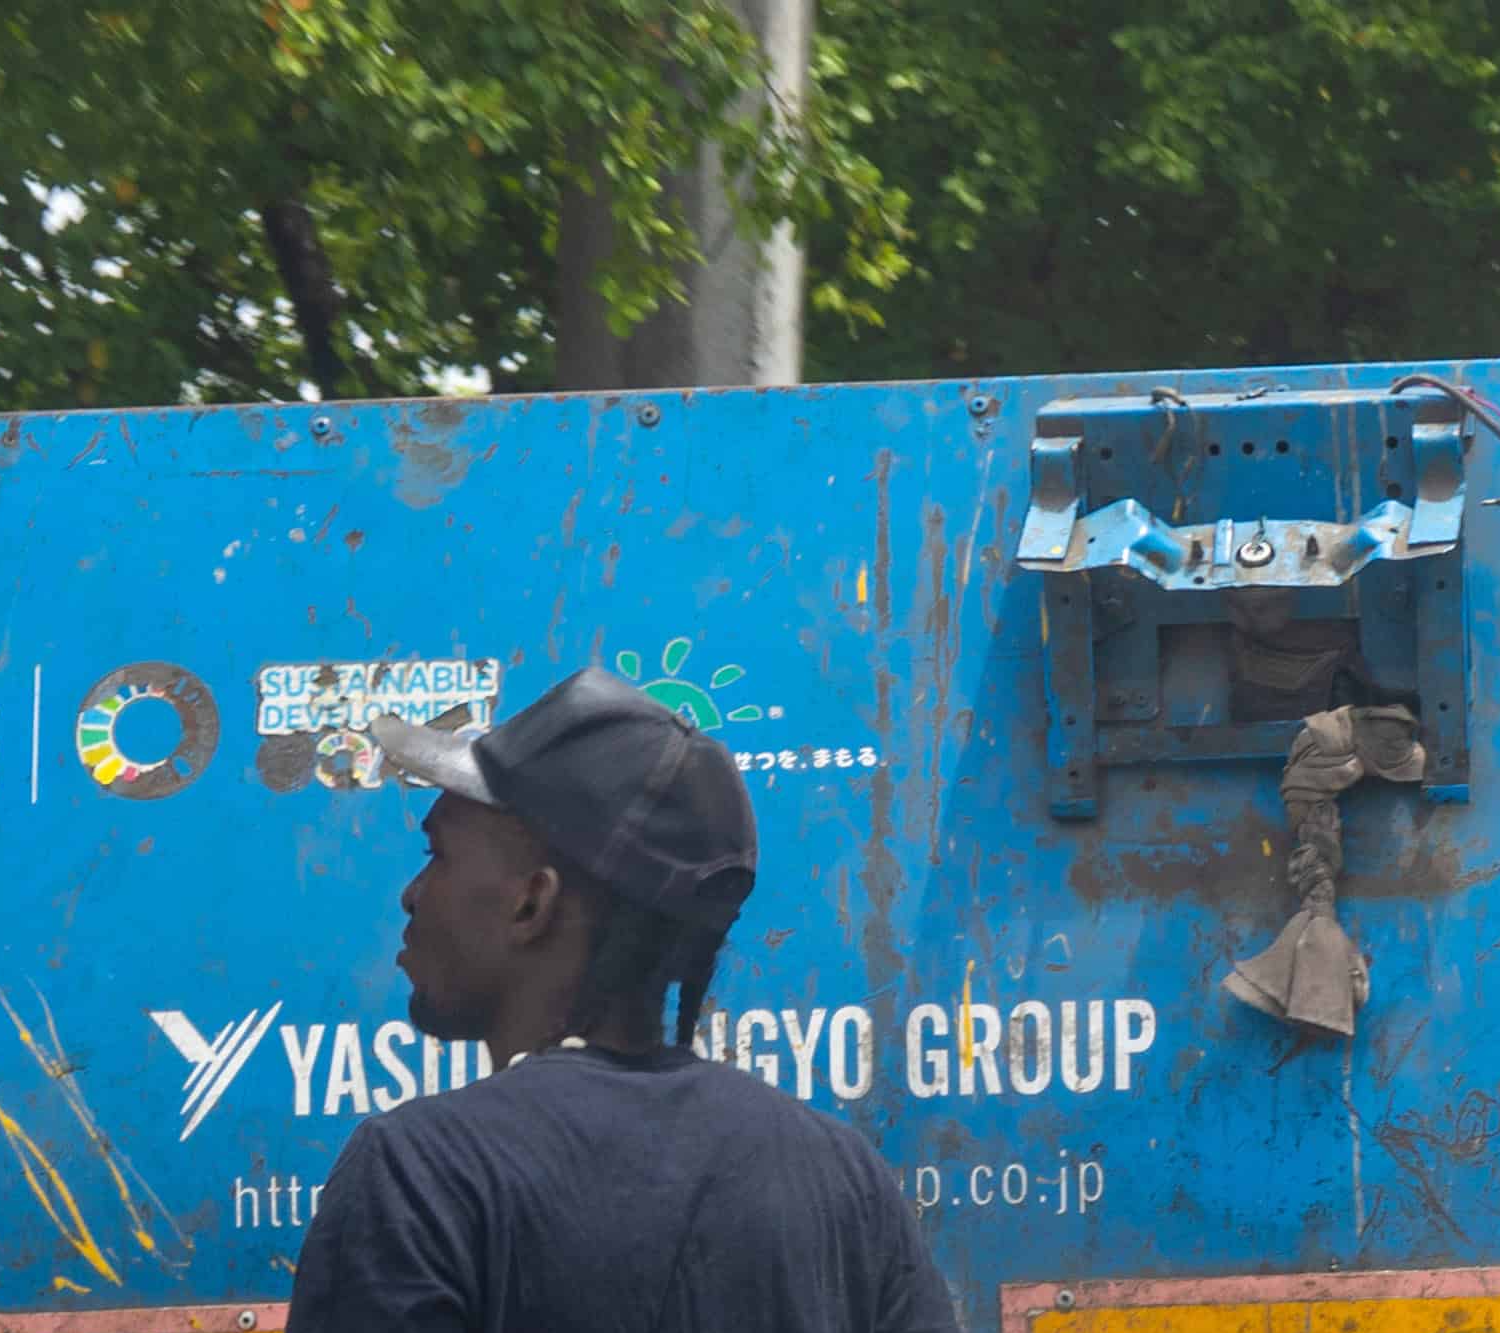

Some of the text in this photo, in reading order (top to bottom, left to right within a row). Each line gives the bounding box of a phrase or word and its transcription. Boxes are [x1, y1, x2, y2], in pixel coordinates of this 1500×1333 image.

[263, 666, 494, 698] SUSTANABLE
[906, 999, 1157, 1098] GROUP
[901, 1149, 1105, 1219] p.co.jp
